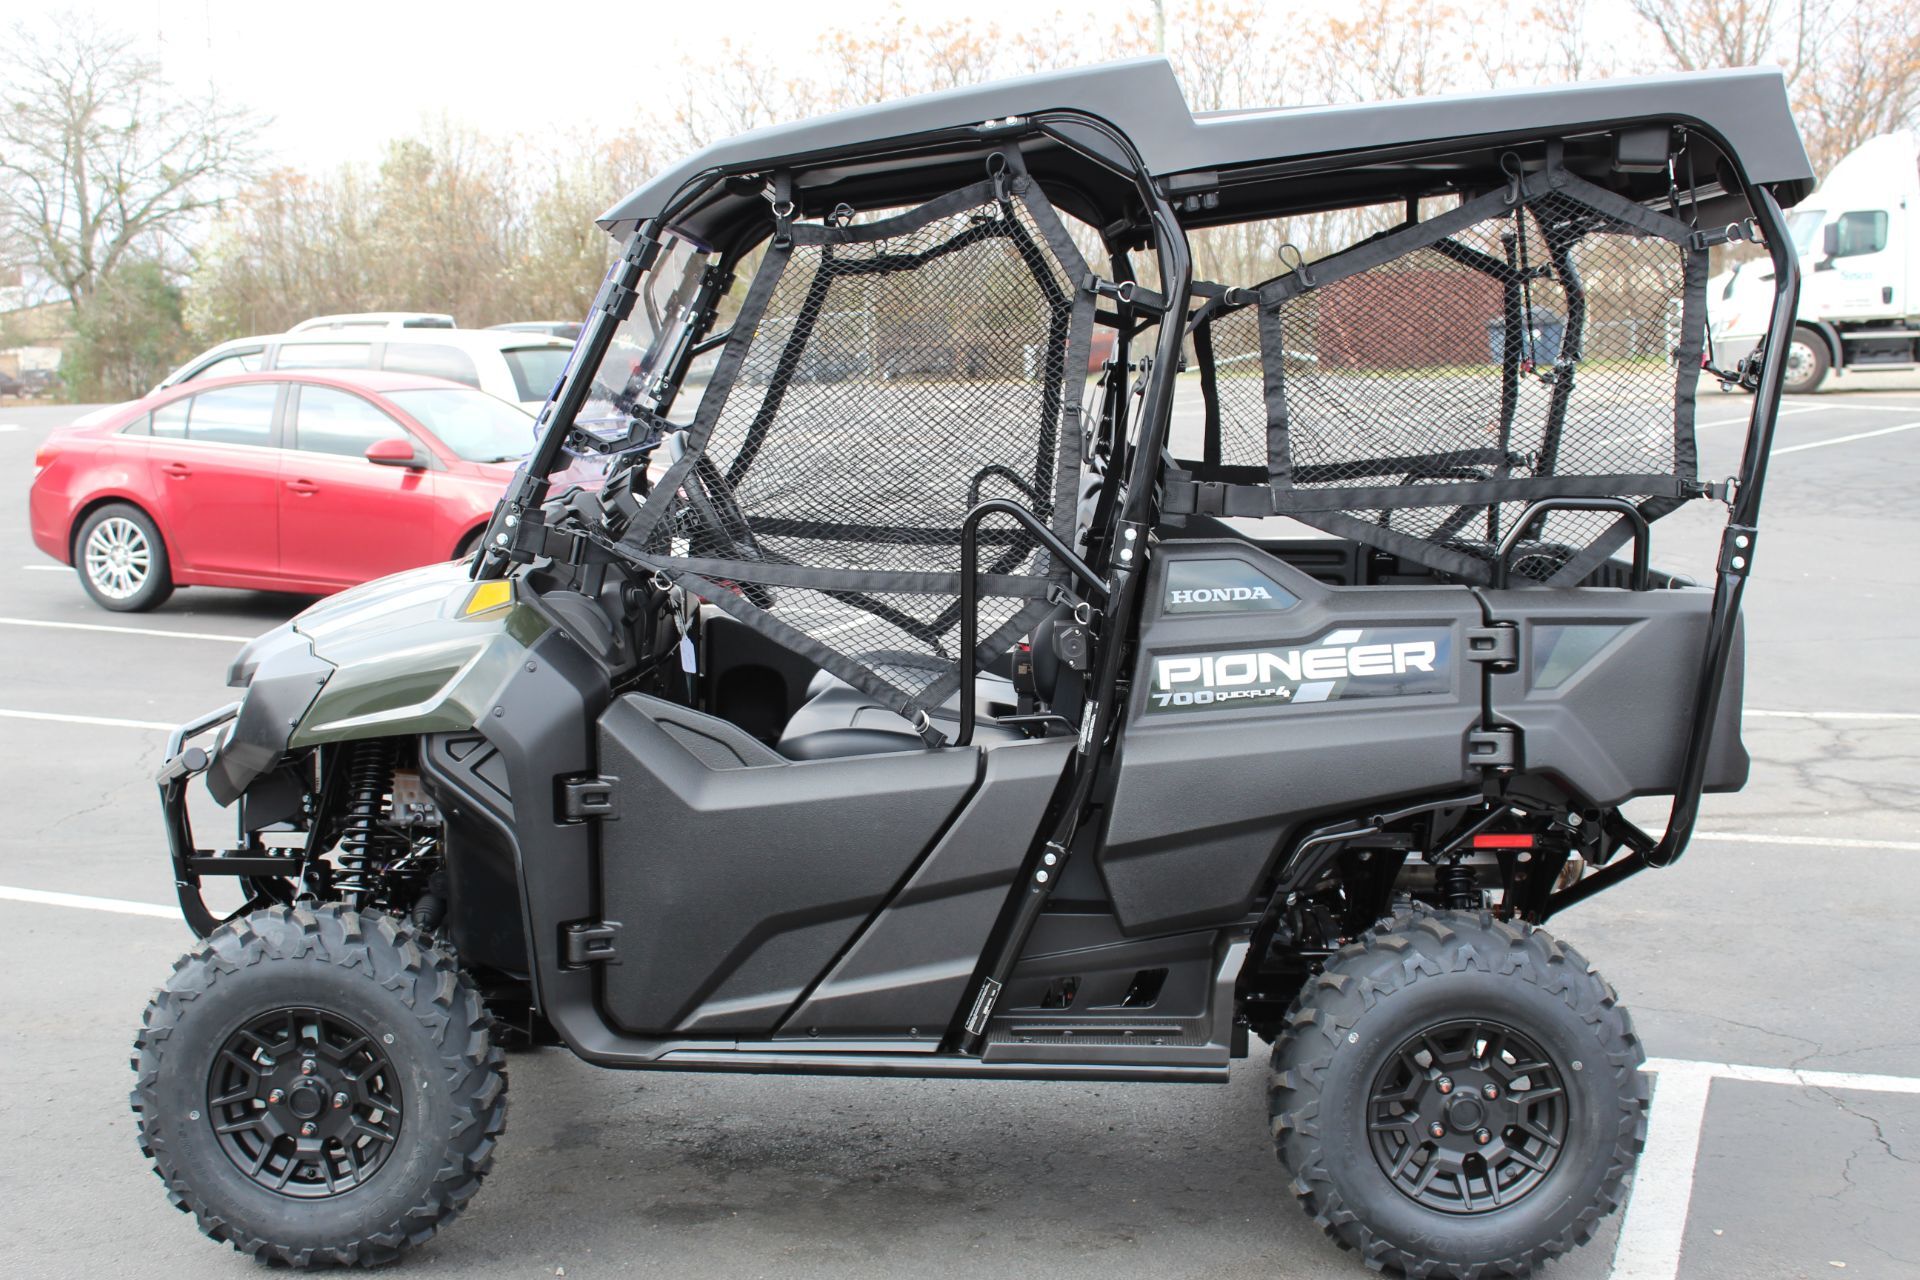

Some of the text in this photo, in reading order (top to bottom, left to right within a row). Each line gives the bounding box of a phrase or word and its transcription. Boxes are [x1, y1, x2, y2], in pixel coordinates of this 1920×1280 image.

[1171, 586, 1272, 604] HONDA
[1158, 640, 1436, 690] PIONEER
[1152, 690, 1214, 707] 700
